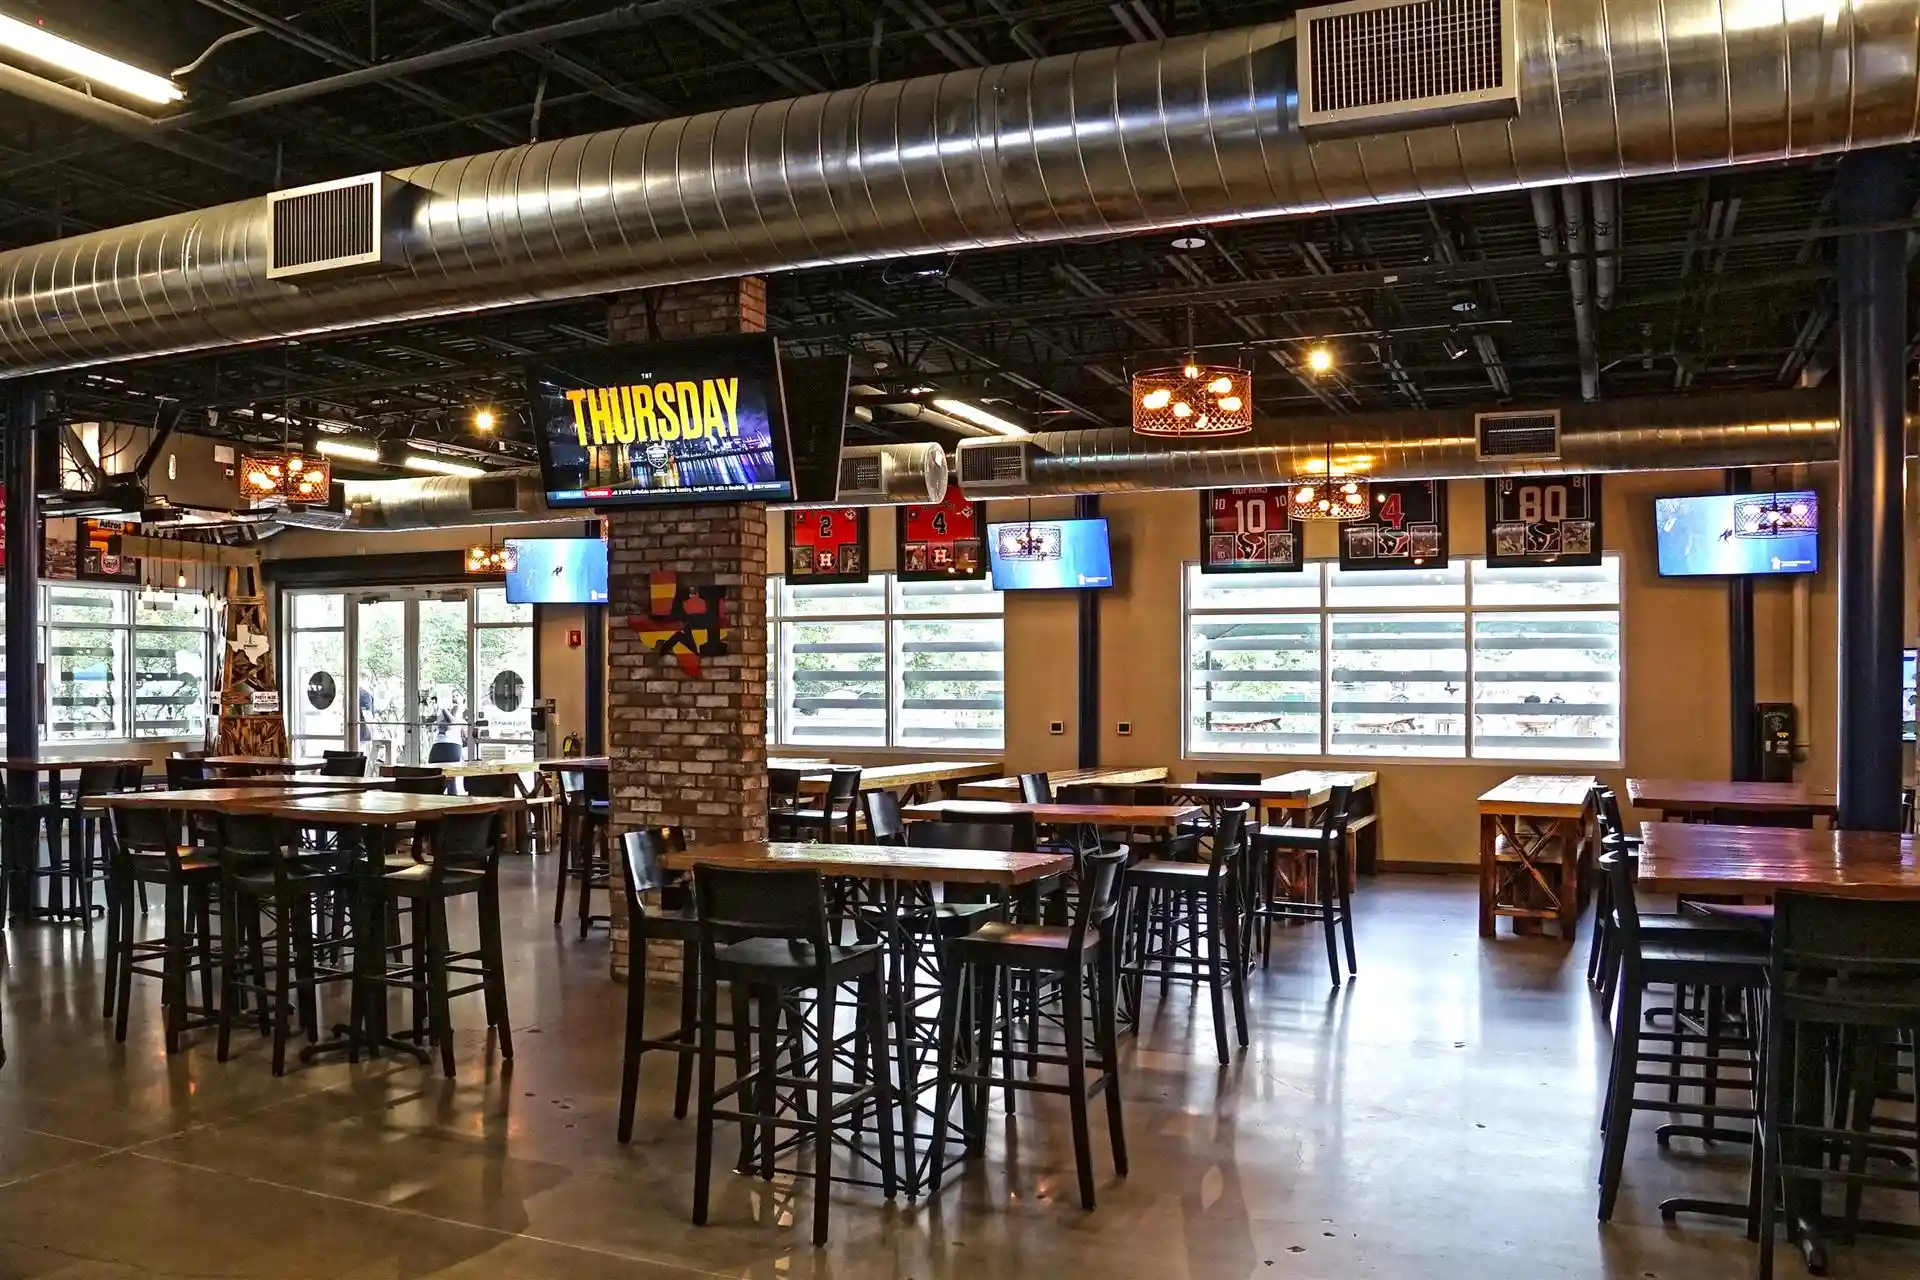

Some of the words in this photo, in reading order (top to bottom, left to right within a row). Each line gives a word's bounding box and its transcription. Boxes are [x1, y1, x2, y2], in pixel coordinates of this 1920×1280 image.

[566, 377, 739, 446] THURSDAY
[1215, 499, 1226, 510] 10
[1275, 495, 1287, 508] 10
[1379, 494, 1405, 529] 4
[1519, 485, 1567, 523] 80
[820, 516, 832, 537] 2
[932, 512, 947, 534] 4
[1235, 499, 1266, 533] 10
[820, 553, 832, 566] H
